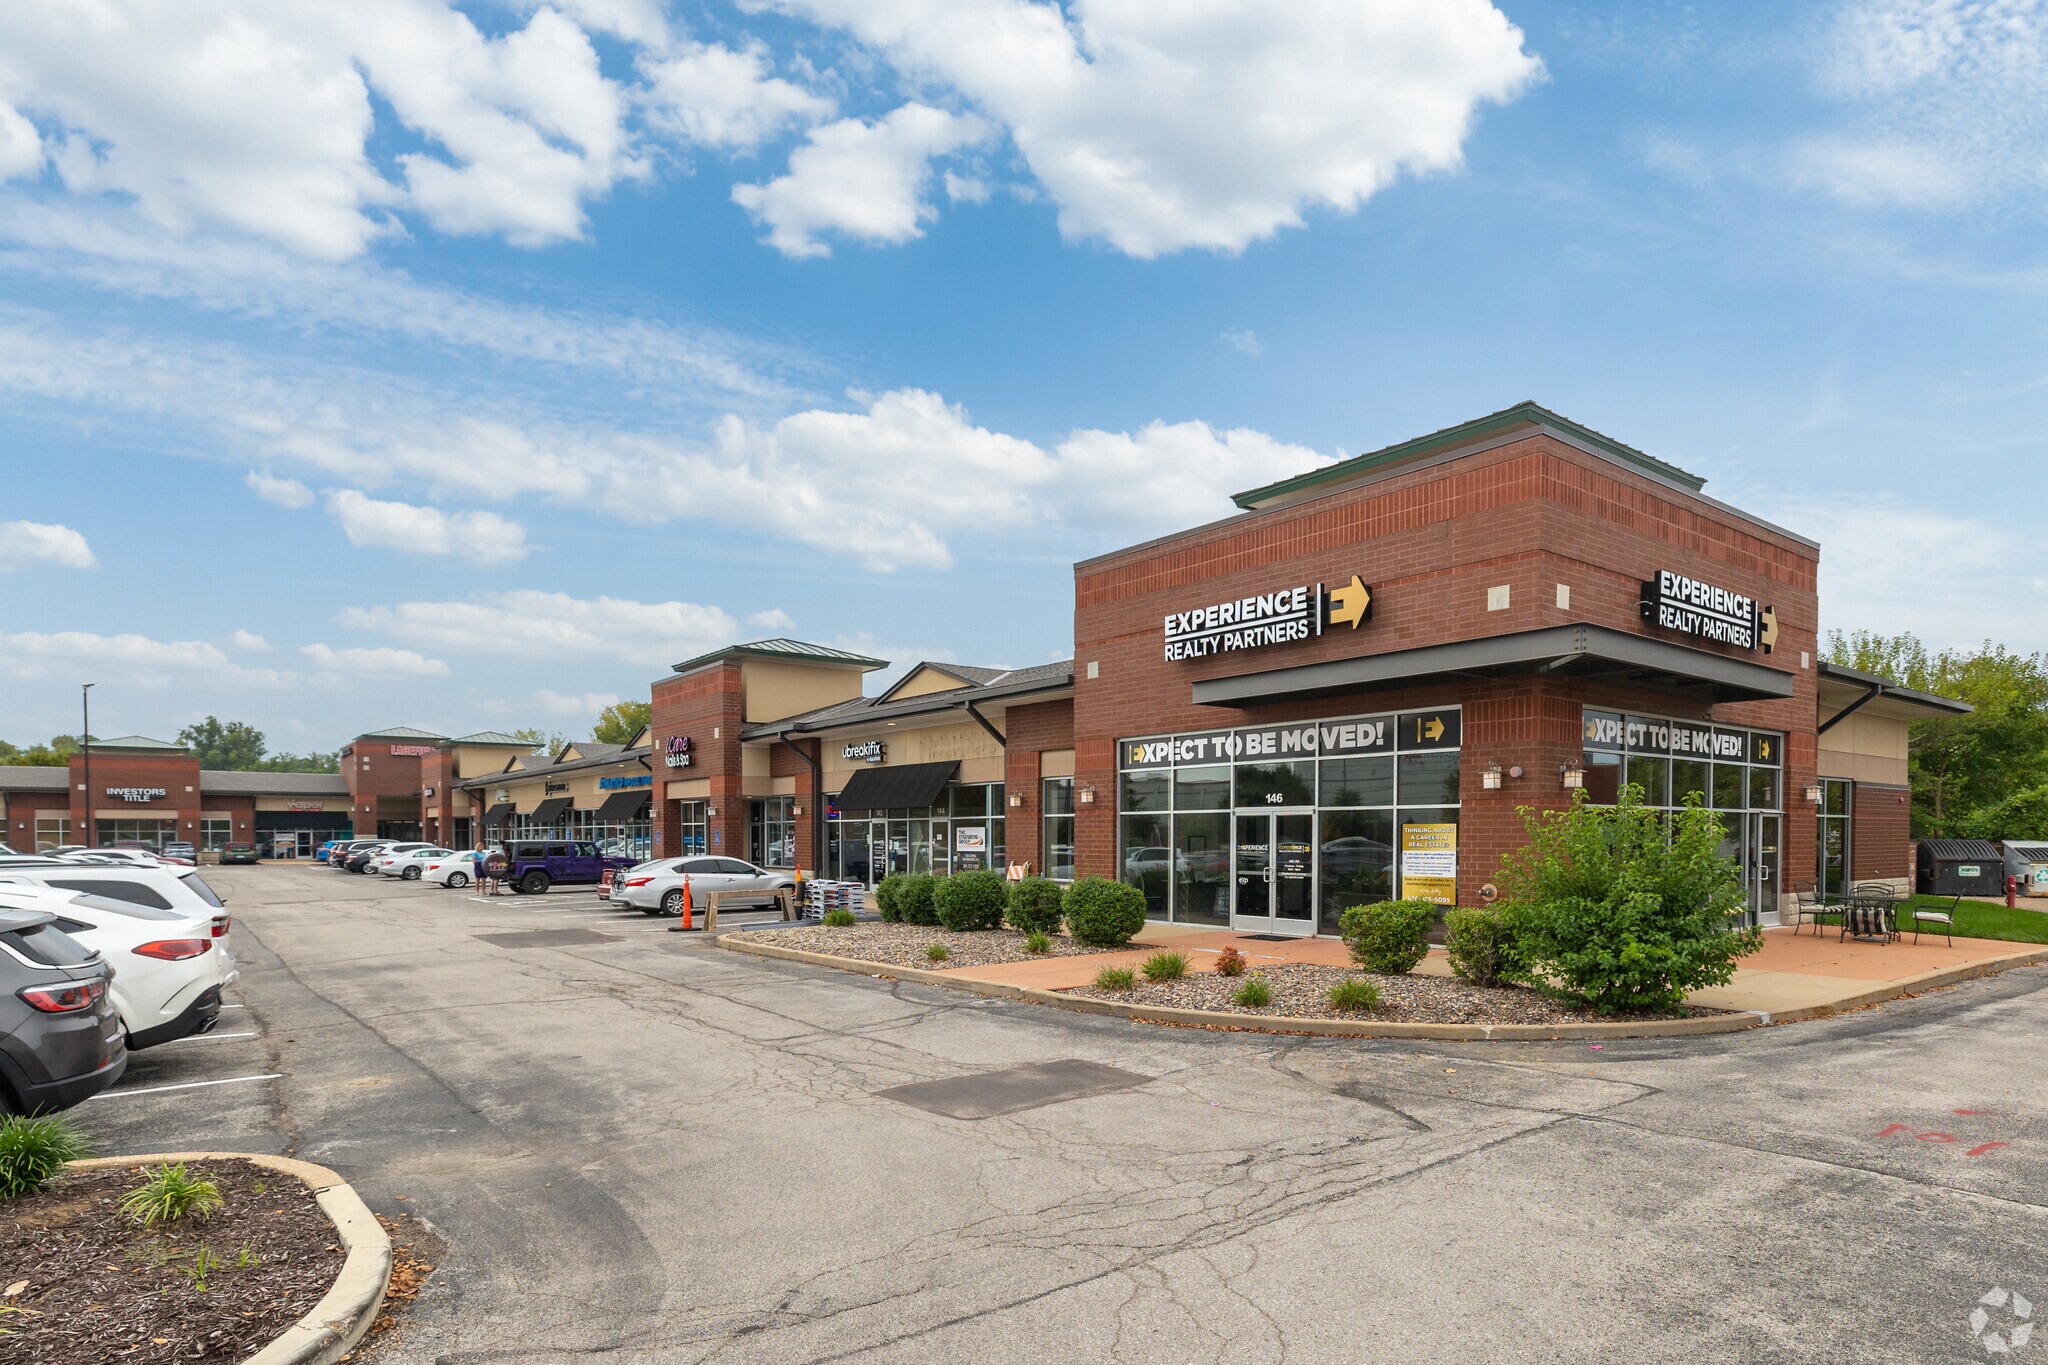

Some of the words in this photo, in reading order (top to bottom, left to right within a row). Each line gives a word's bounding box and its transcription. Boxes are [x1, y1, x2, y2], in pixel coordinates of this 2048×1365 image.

[1164, 586, 1308, 636] EXPERIENCE
[1661, 570, 1752, 620] EXPERIENCE
[1165, 635, 1221, 662] REALTY
[1224, 619, 1309, 652] PARTNERS
[1659, 605, 1702, 635] REALTY
[1703, 618, 1752, 648] PARTNERS
[842, 741, 880, 758] ubreakifix
[1212, 735, 1243, 758] TO
[1246, 731, 1277, 756] BE
[1281, 721, 1384, 753] MOVED!
[1650, 725, 1669, 749] TO
[1671, 728, 1690, 751] BE
[1692, 731, 1743, 757] MOVED!
[123, 794, 151, 802] TITLE
[1265, 793, 1283, 803] 146
